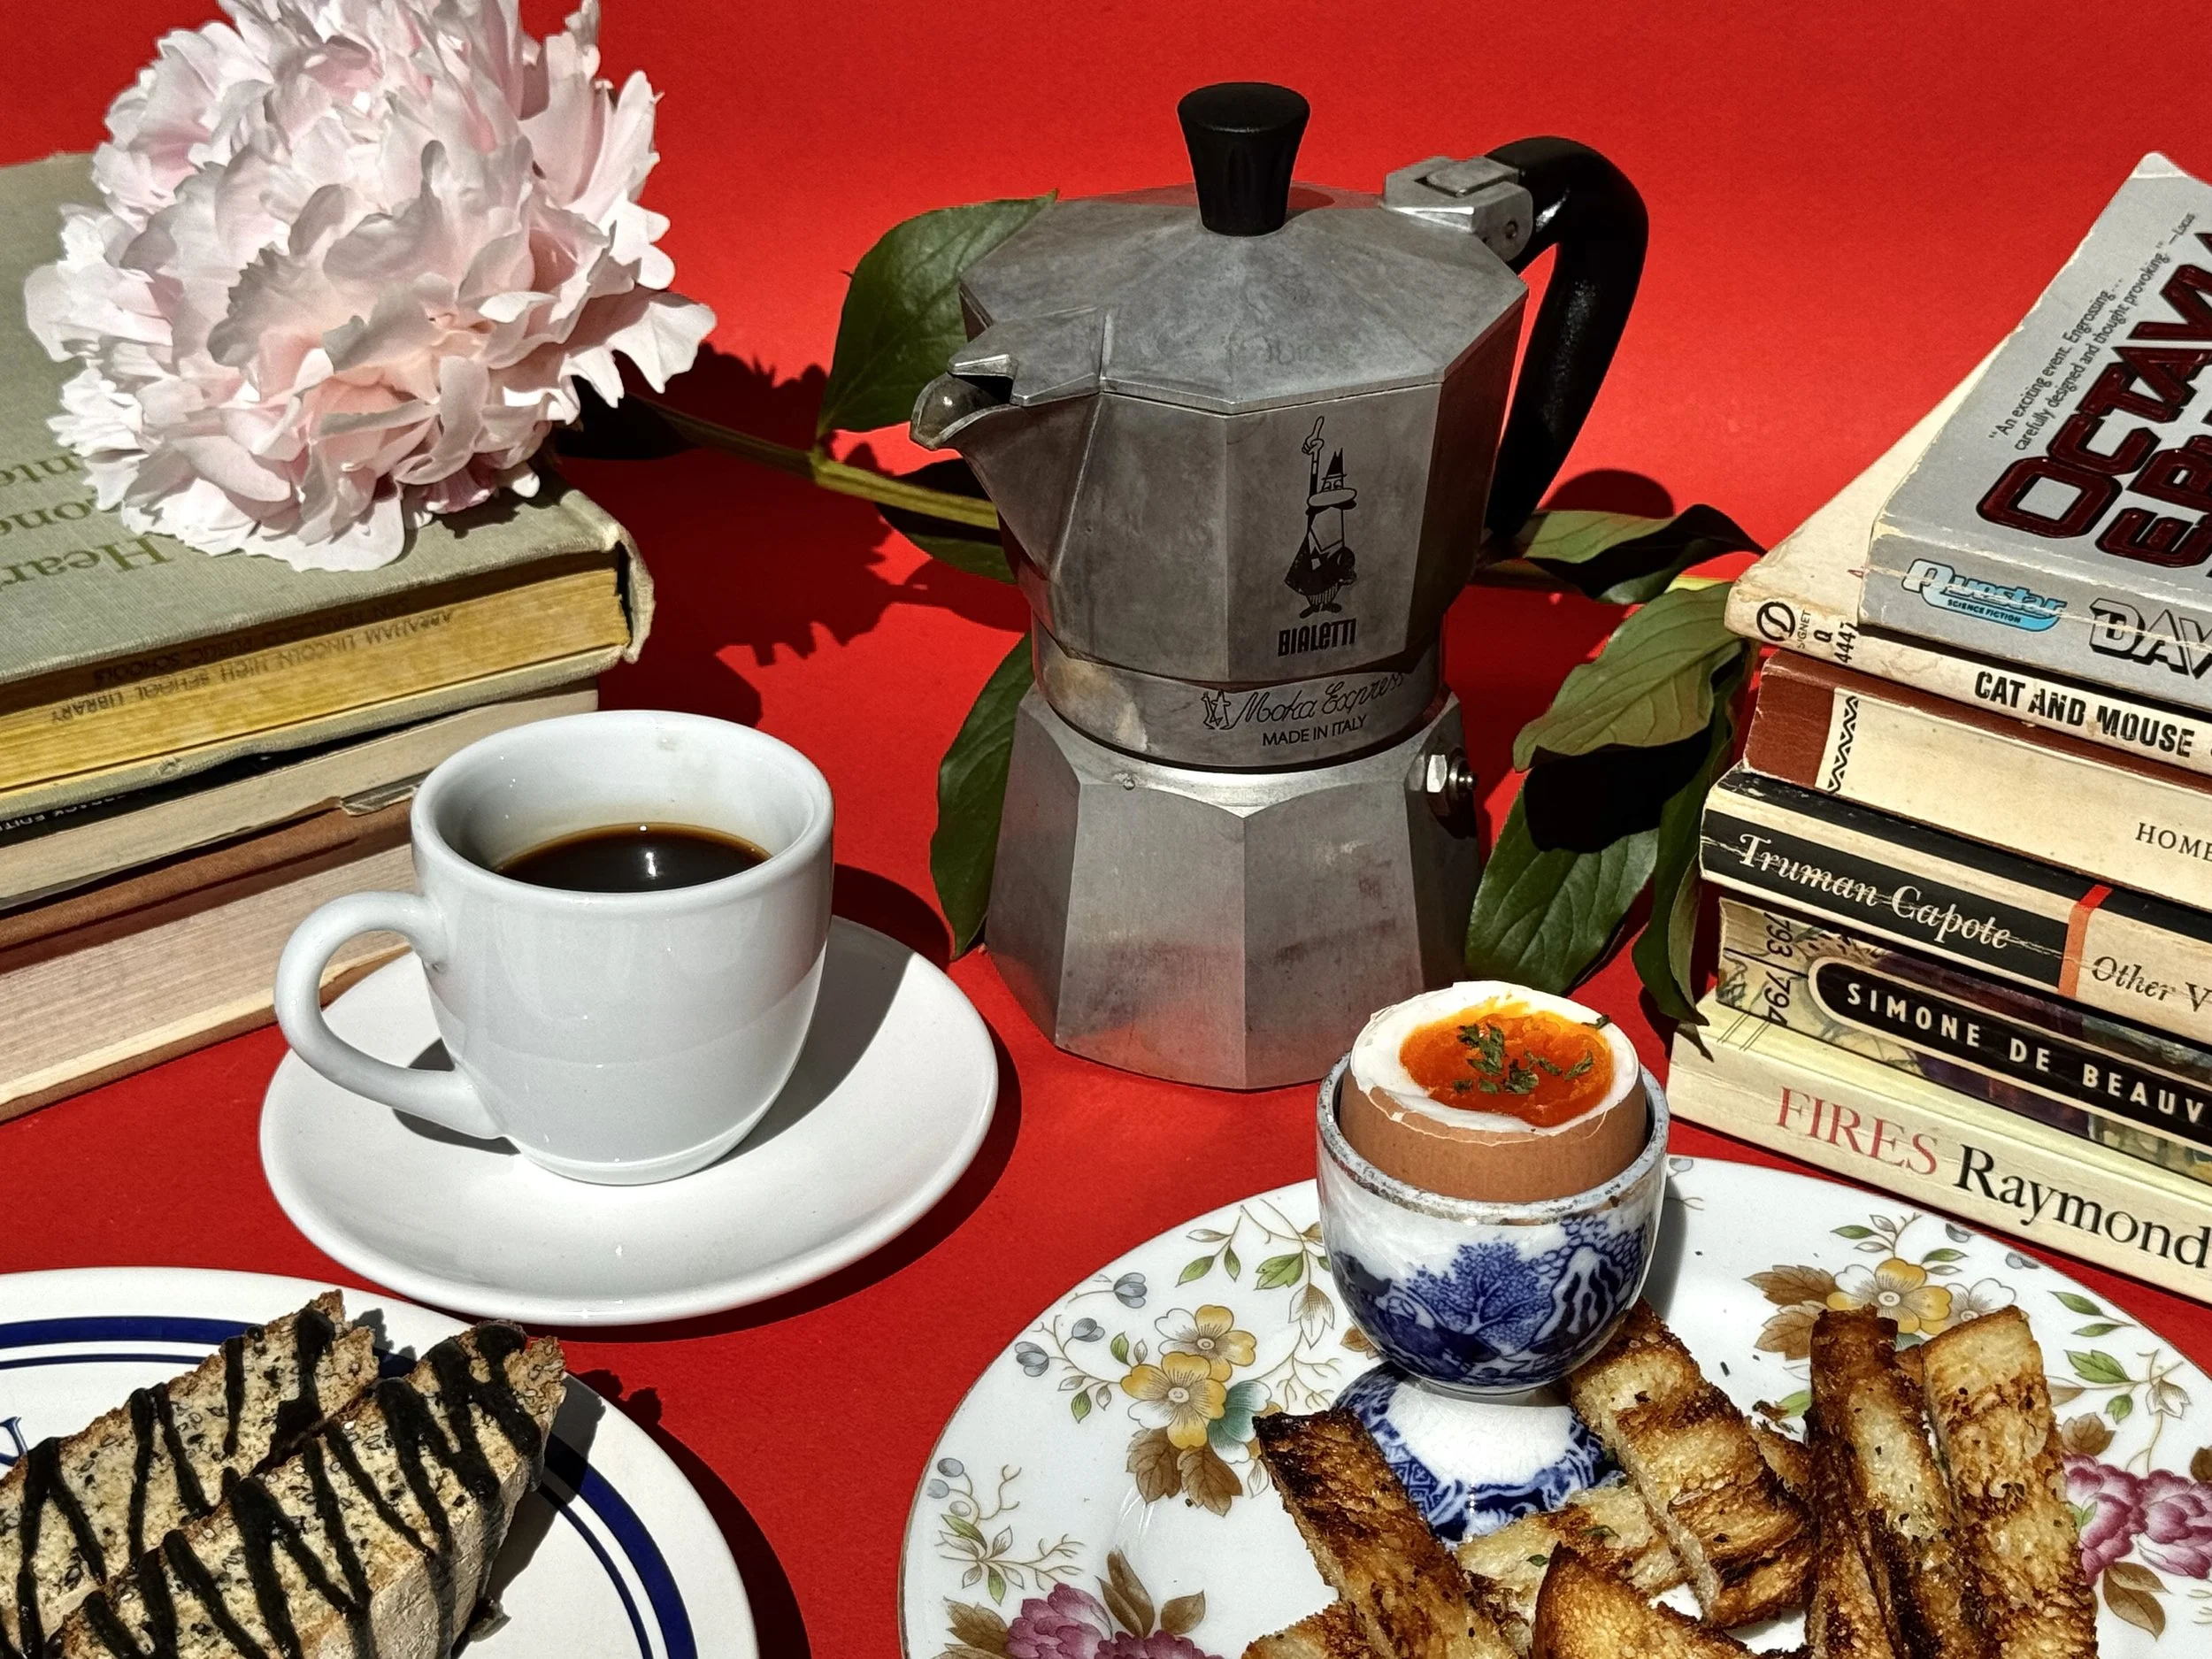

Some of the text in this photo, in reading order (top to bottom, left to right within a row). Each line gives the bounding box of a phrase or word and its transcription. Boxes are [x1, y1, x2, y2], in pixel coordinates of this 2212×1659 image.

[1976, 233, 2212, 539] OCTAV
[2013, 376, 2046, 420] exciting
[2014, 408, 2055, 451] carefully
[2047, 364, 2084, 409] designed
[2083, 342, 2101, 365] and
[2092, 303, 2131, 351] thought
[0, 537, 177, 593] Hear
[1947, 599, 2021, 624] SCIENCE FICTION
[219, 653, 270, 681] HIGH
[278, 633, 354, 668] LINCOLN
[50, 692, 126, 725] LIBRARY
[1226, 672, 1405, 729] Moka Express
[1974, 671, 2195, 758] CAT AND MOUSE
[1263, 715, 1367, 746] MADE IN ITALY
[1739, 833, 1878, 907] Truman
[1891, 885, 2011, 950] Capote
[2092, 956, 2177, 1002] Other
[1847, 982, 2205, 1125] SIMONE DE BEAUV
[1774, 1086, 2211, 1270] FIRES Raymond
